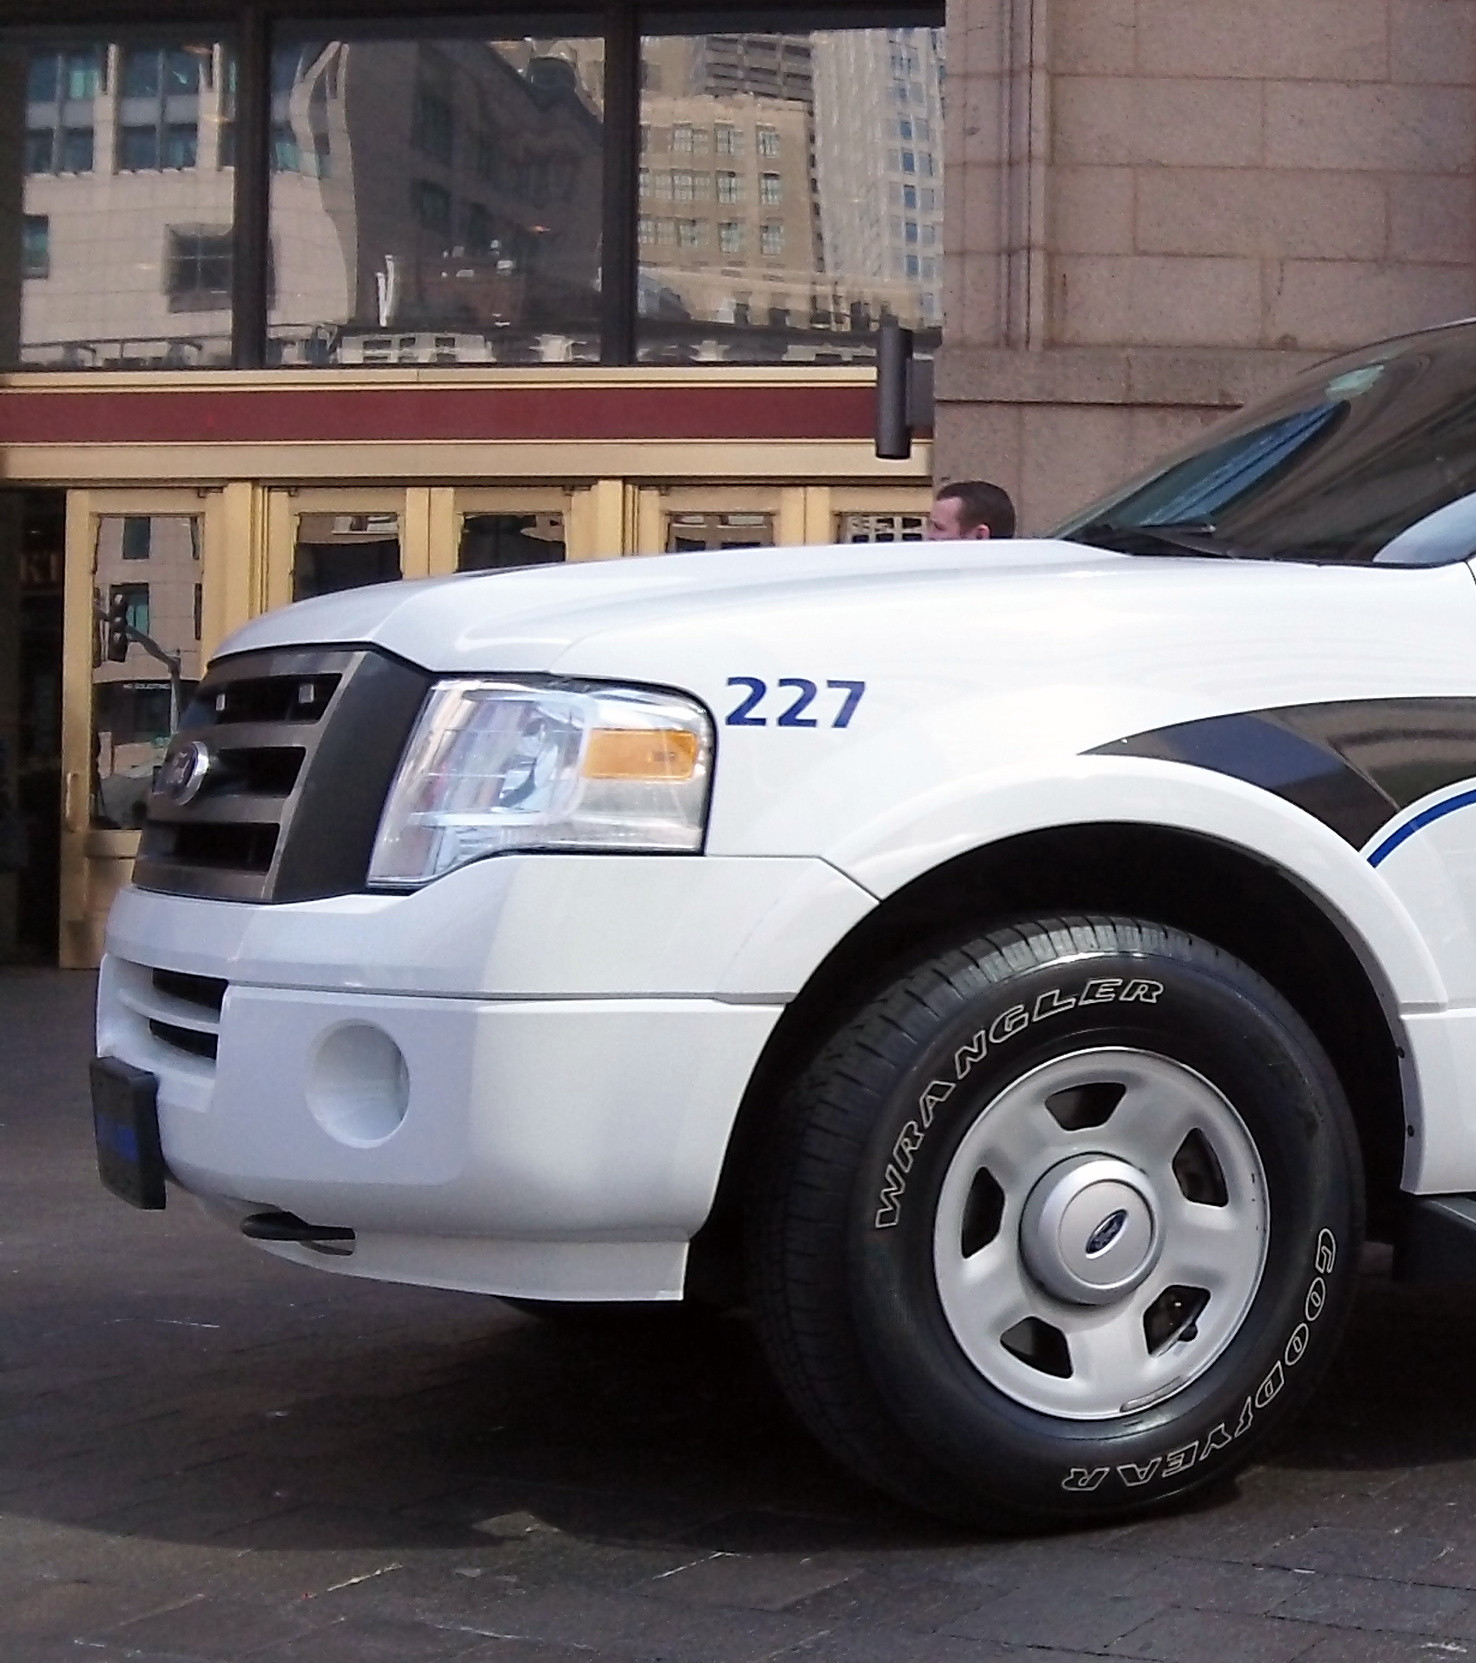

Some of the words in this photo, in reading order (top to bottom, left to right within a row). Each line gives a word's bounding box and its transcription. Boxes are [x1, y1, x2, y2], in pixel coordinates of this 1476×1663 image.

[725, 676, 866, 728] 227
[874, 978, 1164, 1230] WRANGLER
[1061, 1227, 1337, 1492] GOODYEAR
